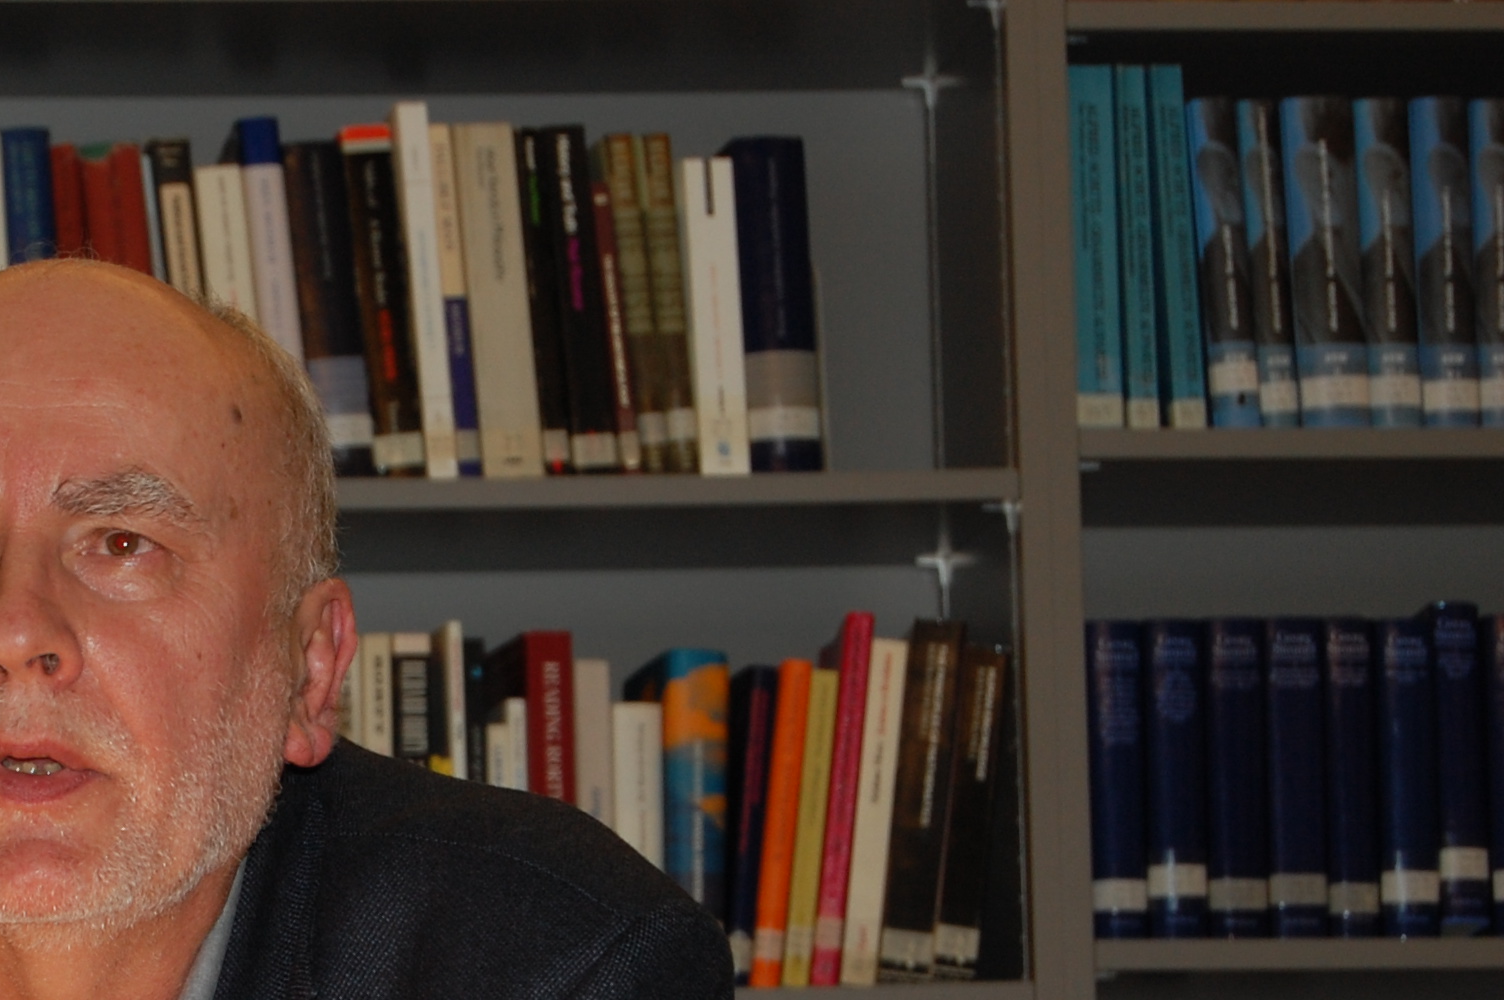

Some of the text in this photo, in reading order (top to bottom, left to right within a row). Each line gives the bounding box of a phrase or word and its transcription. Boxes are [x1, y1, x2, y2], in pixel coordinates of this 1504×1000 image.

[556, 134, 570, 176] History
[560, 180, 572, 201] and
[542, 660, 564, 741] READING
